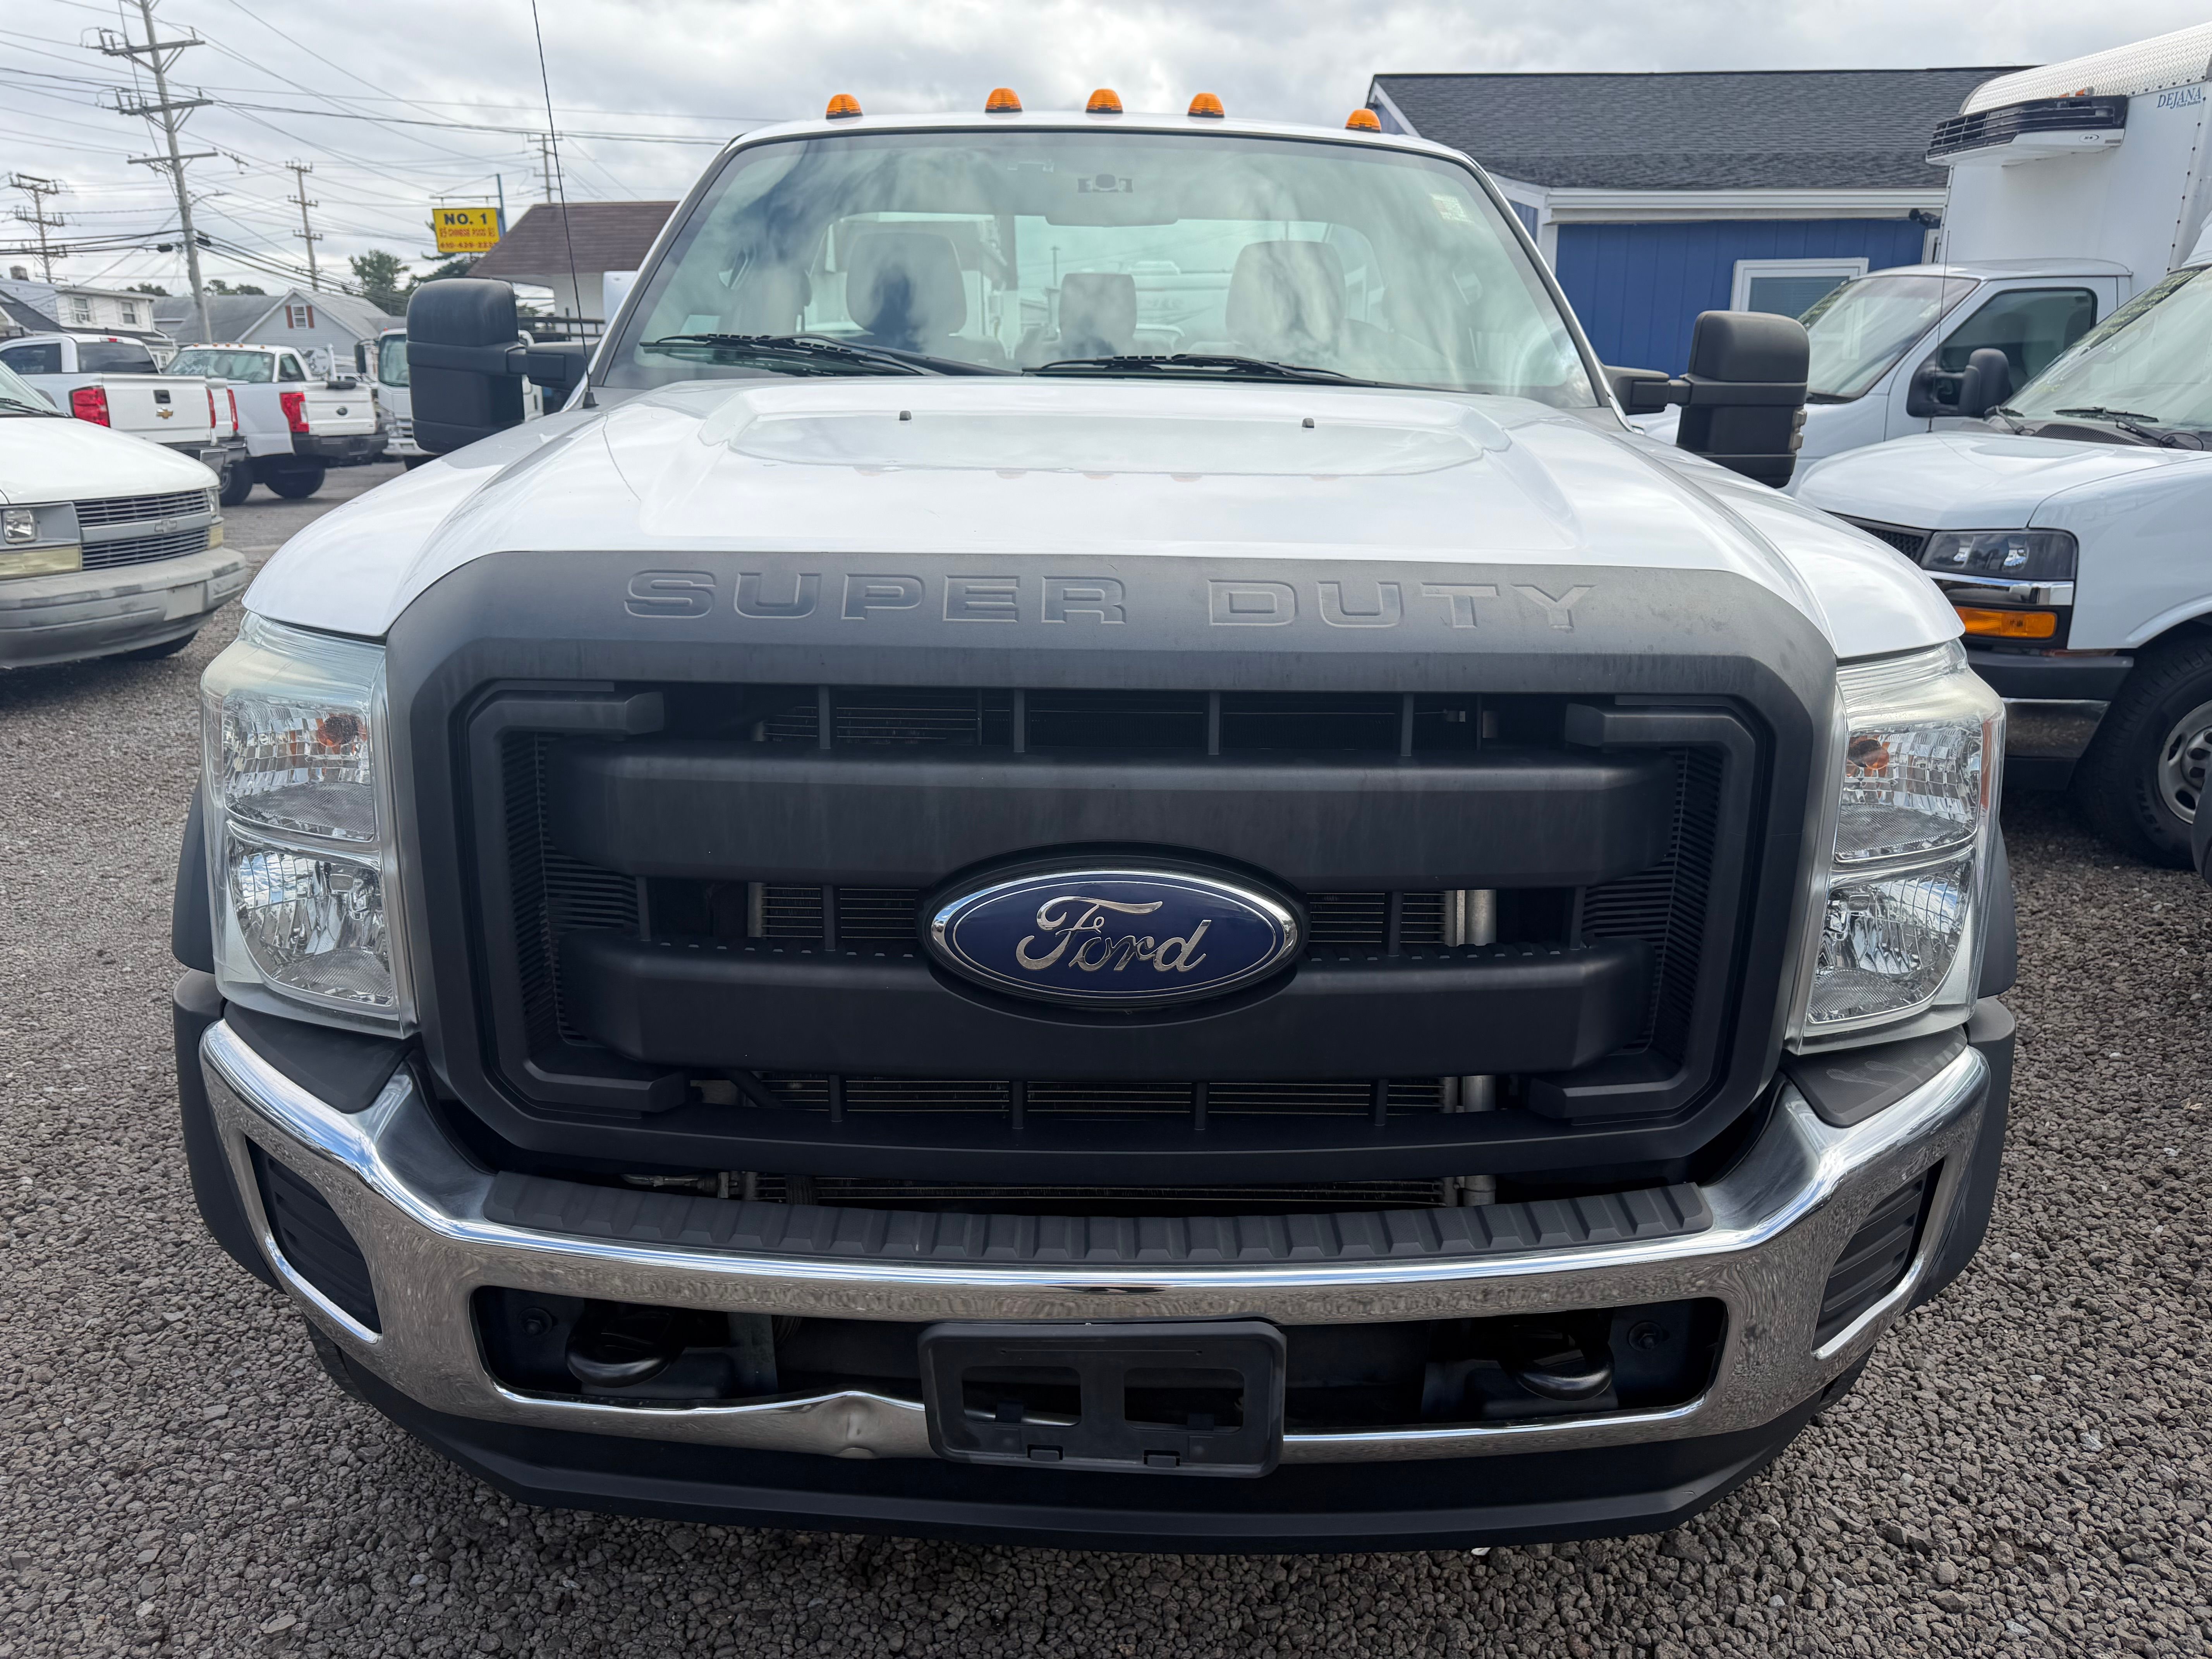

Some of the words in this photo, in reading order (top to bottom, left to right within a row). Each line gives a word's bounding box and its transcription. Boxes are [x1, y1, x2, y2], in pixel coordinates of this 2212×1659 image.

[2157, 86, 2201, 109] DEJANA
[444, 213, 474, 225] NO.
[480, 213, 487, 225] 1
[624, 569, 1127, 624] SUPER
[1207, 579, 1597, 629] DUTY
[1015, 896, 1212, 972] Ford
